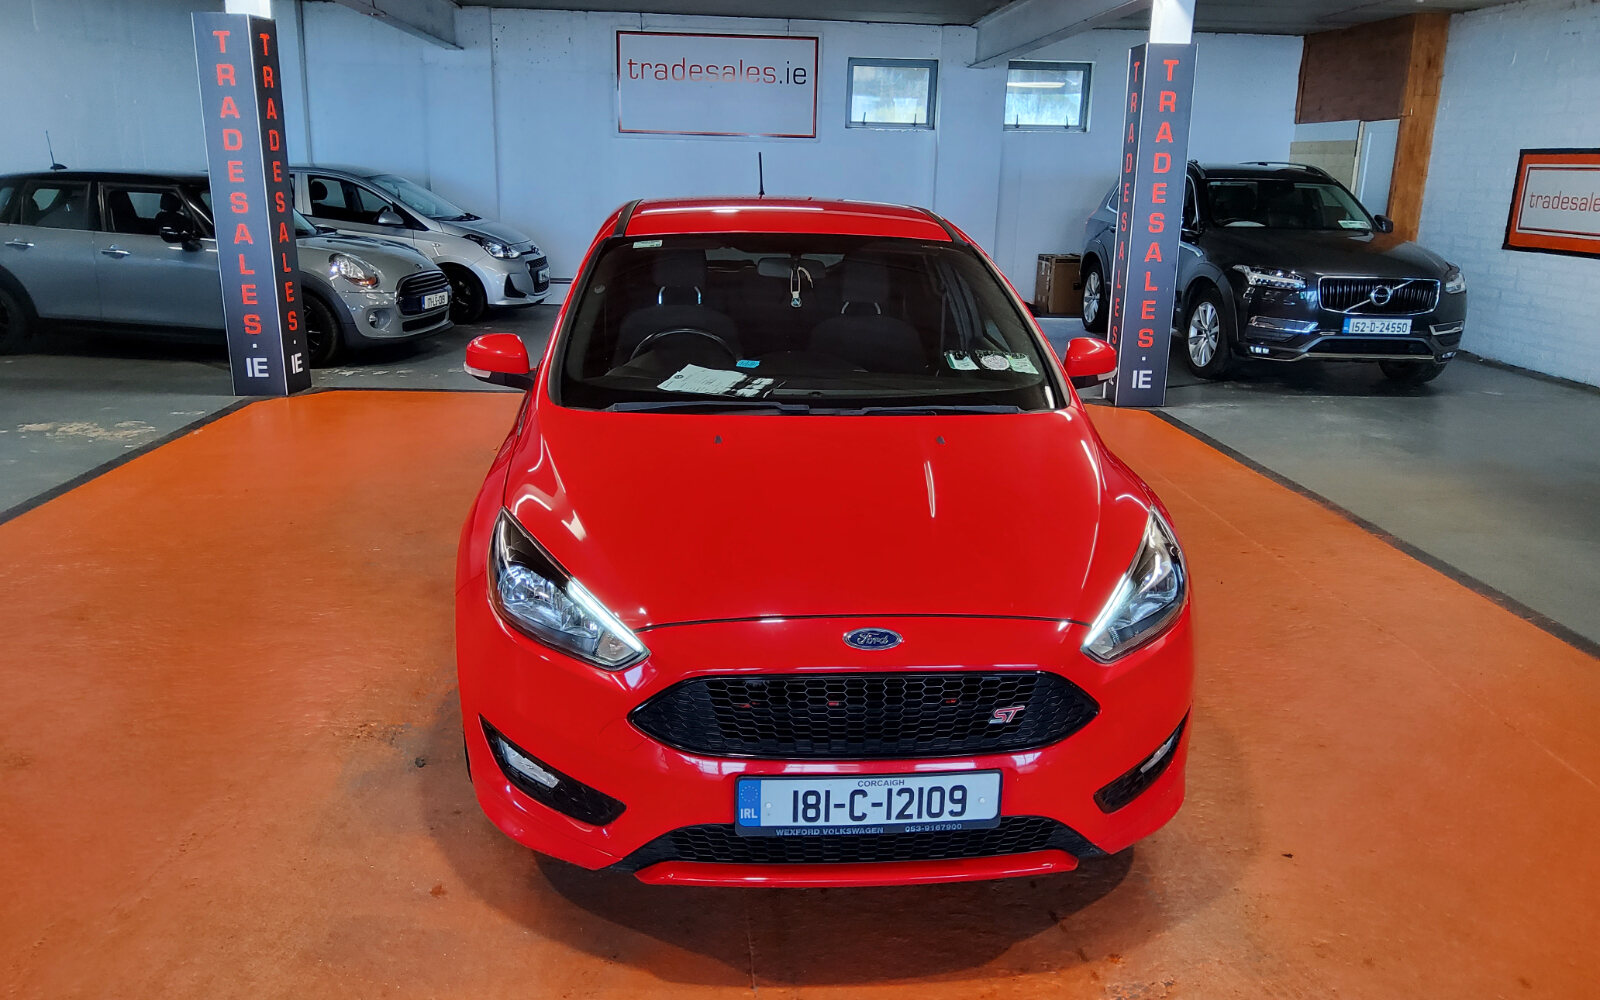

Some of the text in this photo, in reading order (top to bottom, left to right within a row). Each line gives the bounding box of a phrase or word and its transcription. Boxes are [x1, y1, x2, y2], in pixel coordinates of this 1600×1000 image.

[627, 57, 807, 85] tradesales.ie
[1351, 321, 1408, 333] 152-D-24550
[856, 631, 889, 646] Ford
[989, 705, 1026, 724] ST
[857, 779, 905, 788] CORCAIGH
[792, 785, 968, 823] 181-C-12109
[740, 808, 758, 819] IRL
[776, 827, 884, 836] WEXFORD VOLKSWAGEN
